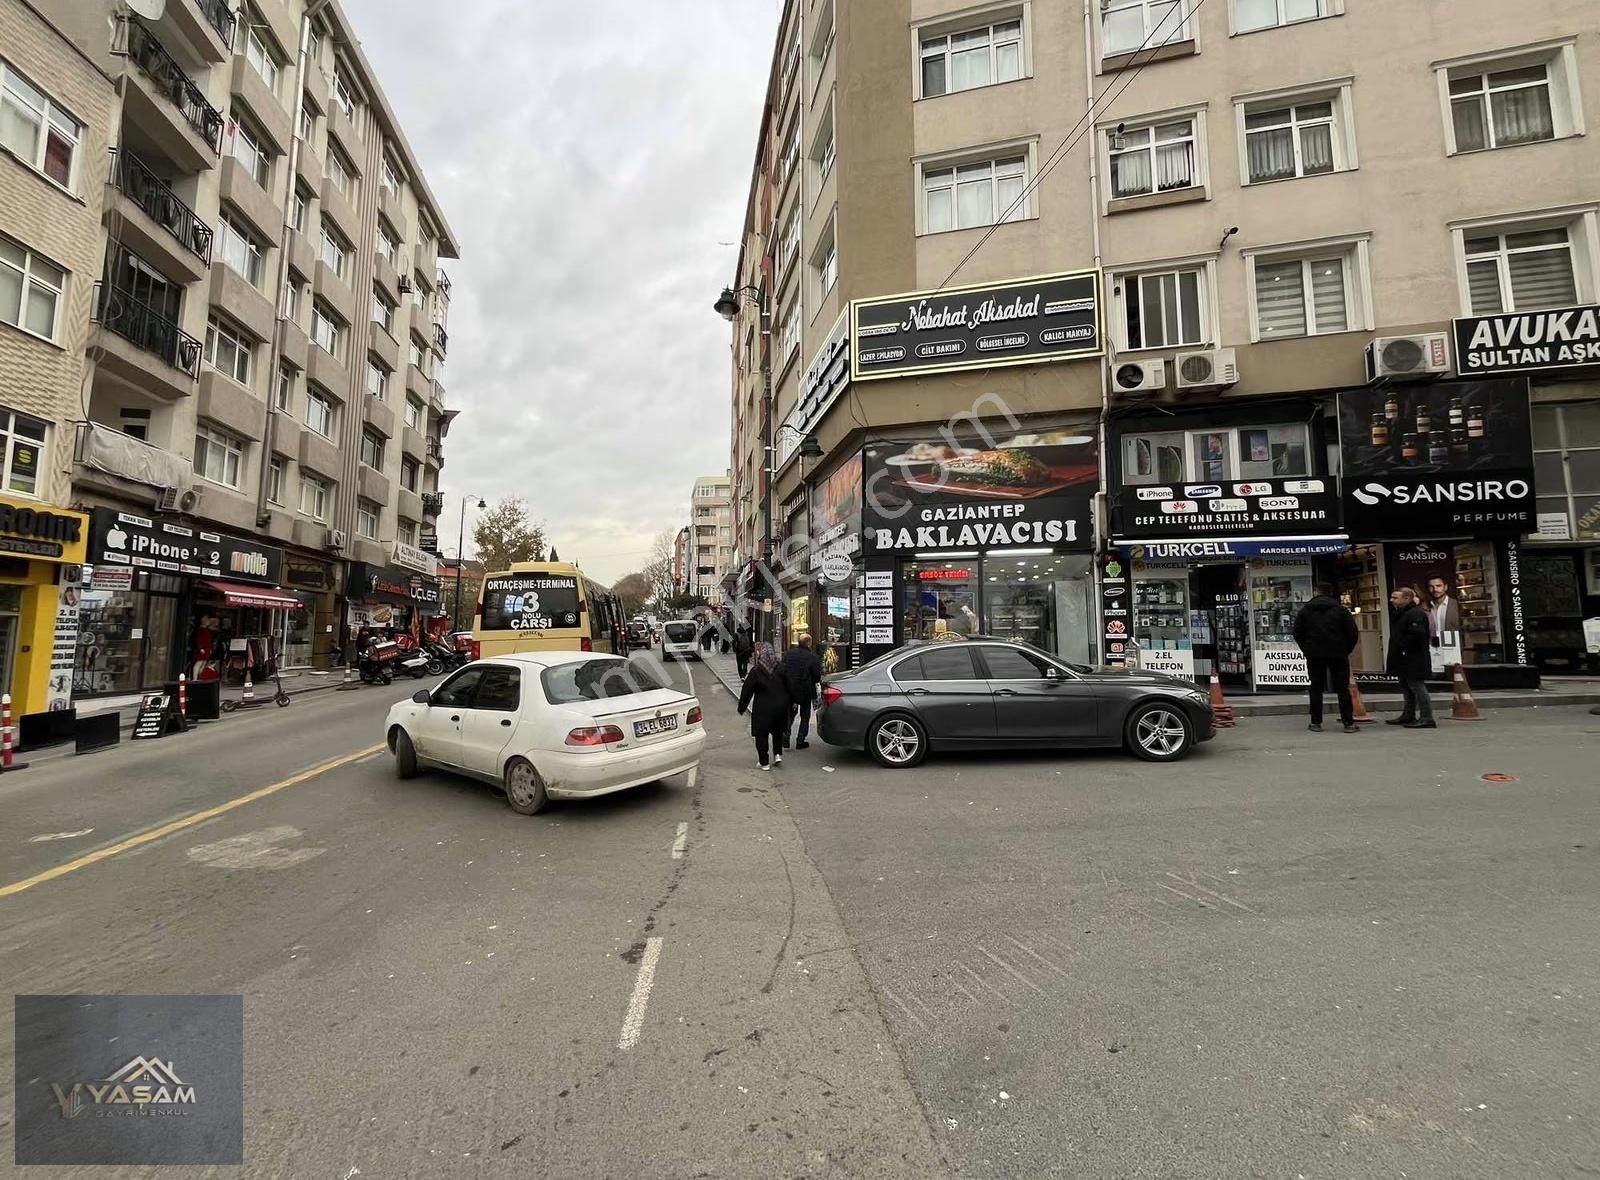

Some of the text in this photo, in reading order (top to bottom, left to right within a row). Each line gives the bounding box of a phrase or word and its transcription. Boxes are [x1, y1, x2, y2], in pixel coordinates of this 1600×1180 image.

[902, 294, 1040, 330] Nebahat Aksakal
[1044, 329, 1092, 342] KALICI MAKYAJ
[1468, 310, 1600, 349] AVUKA
[922, 344, 960, 355] CİLT BAKIMI
[860, 353, 876, 362] LAZER
[1468, 347, 1550, 368] SULTAN
[921, 504, 1026, 522] GAZİANTEP
[1136, 516, 1156, 525] CEP
[1159, 514, 1212, 524] TELEFONU
[1263, 510, 1326, 521] AKSESUAR
[1454, 512, 1528, 522] PERFUME
[876, 520, 1078, 549] BAKLAVACISI
[1145, 542, 1236, 558] TURKCELL
[210, 552, 220, 565] 2
[1266, 558, 1309, 566] TURKCELL
[522, 592, 540, 613] 3
[510, 618, 552, 630] ÇARŞI
[1264, 652, 1305, 660] AKSESUA
[1268, 662, 1306, 672] DÜNYASI
[1290, 674, 1310, 682] SERV
[640, 722, 648, 732] 34
[650, 722, 658, 730] EL
